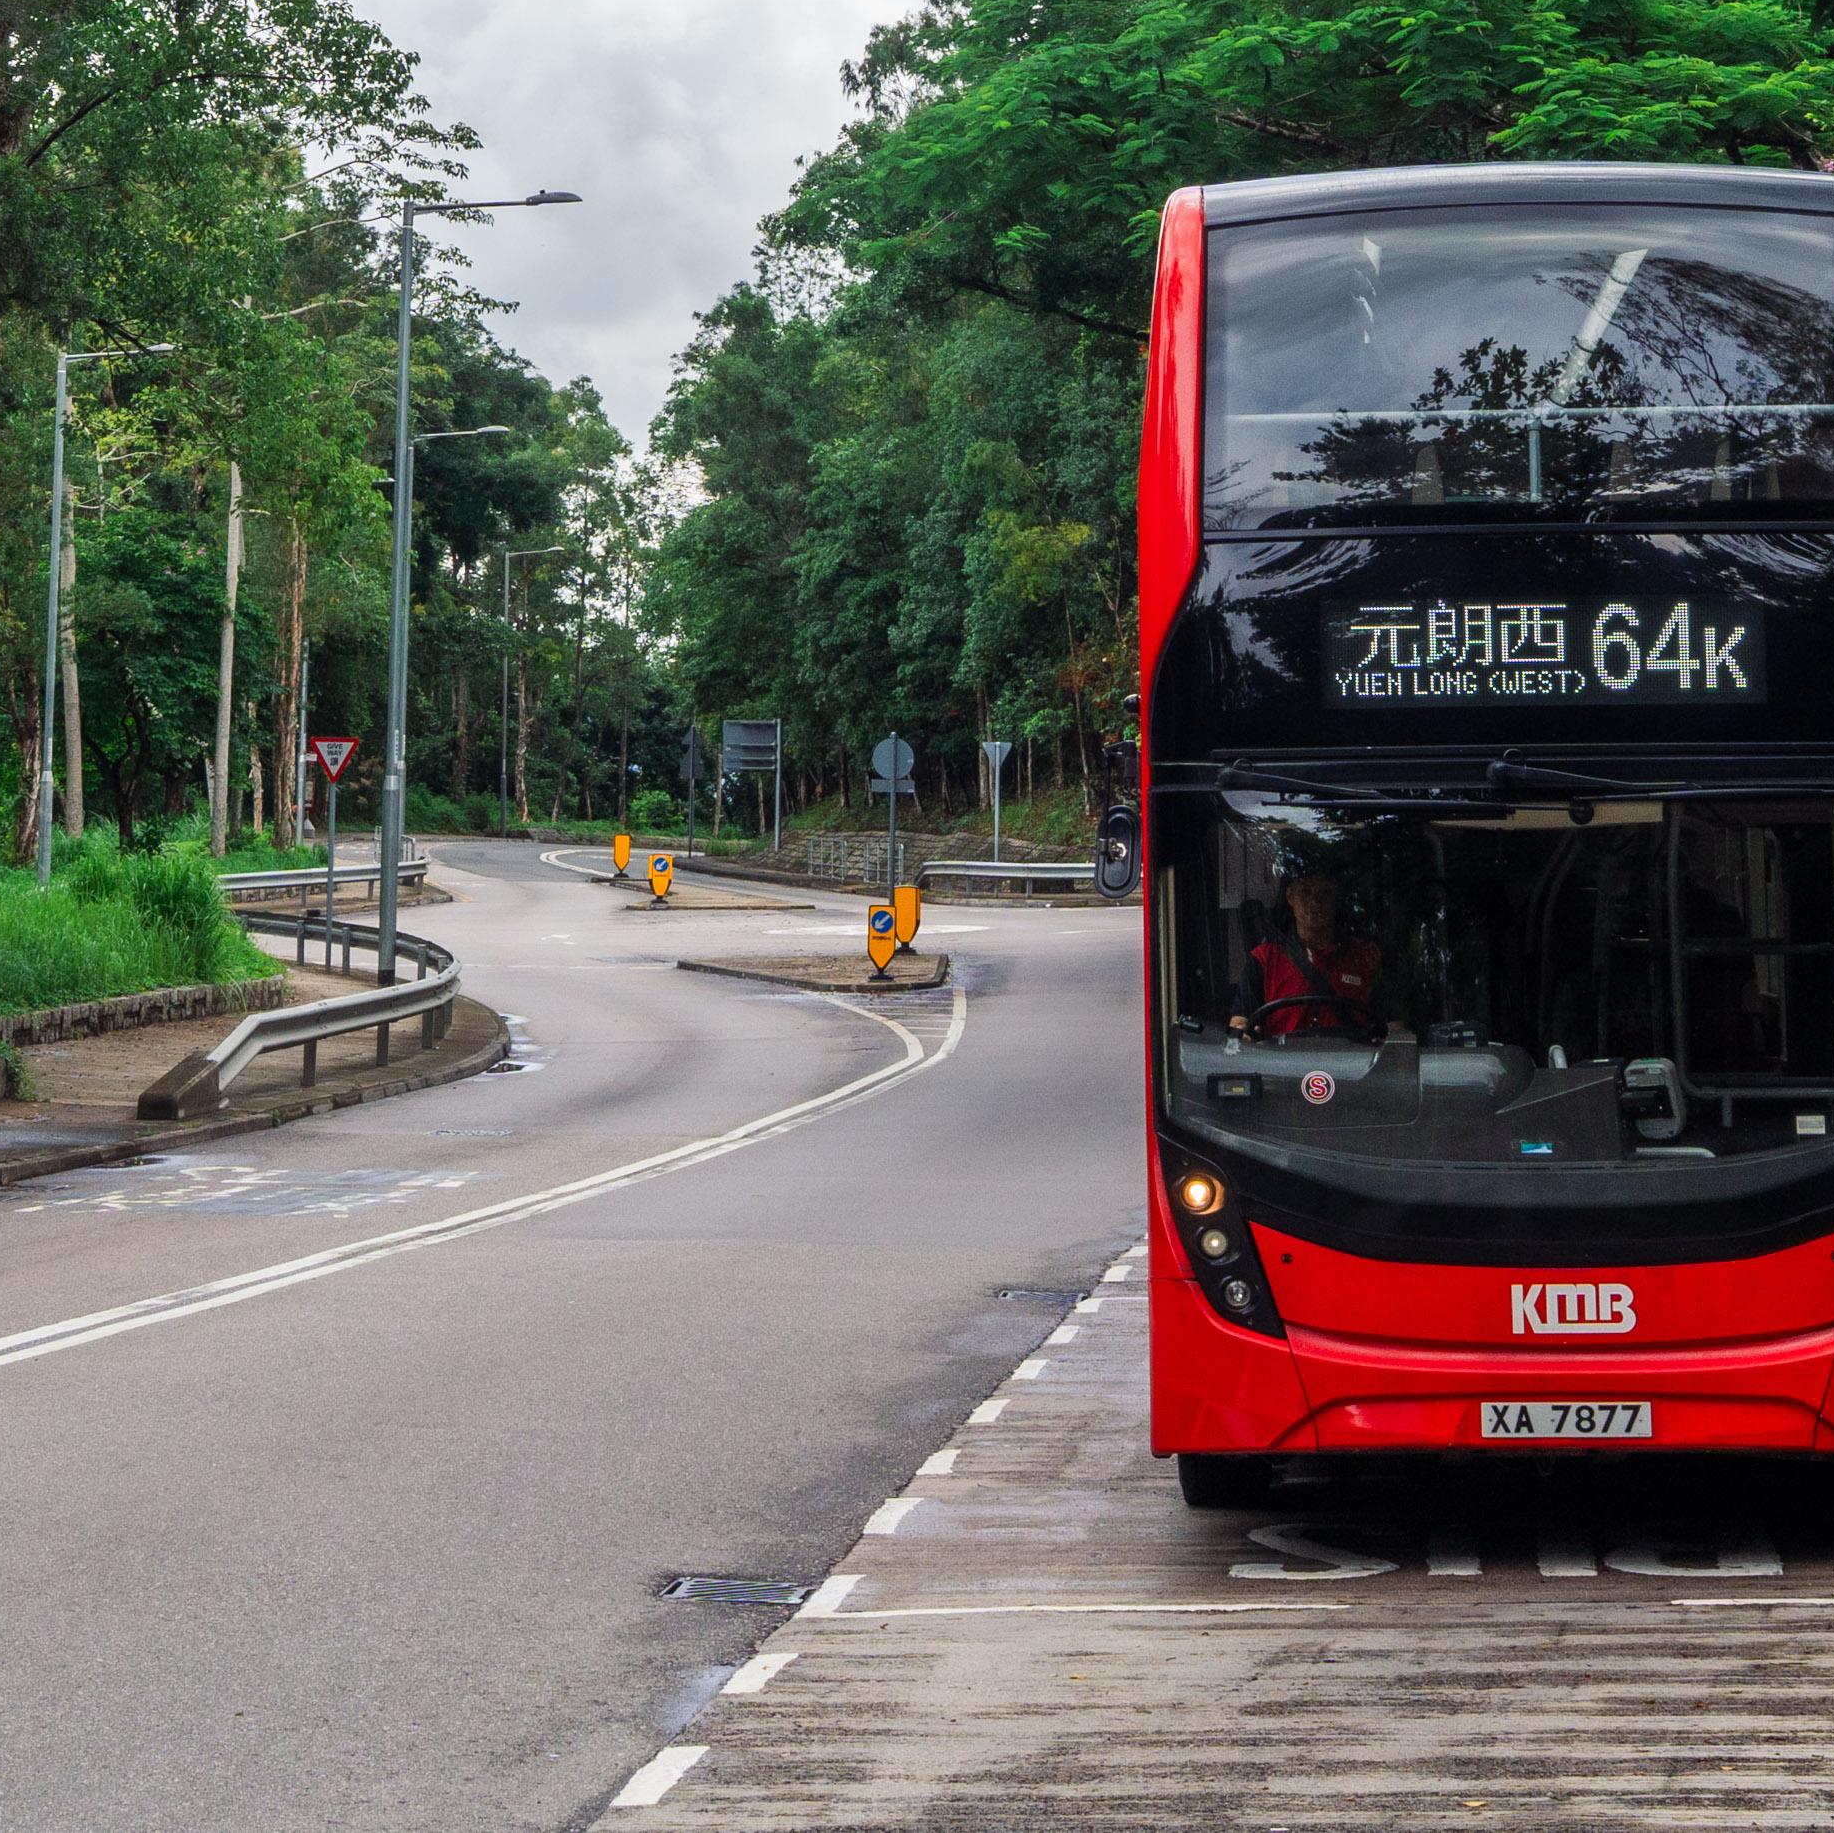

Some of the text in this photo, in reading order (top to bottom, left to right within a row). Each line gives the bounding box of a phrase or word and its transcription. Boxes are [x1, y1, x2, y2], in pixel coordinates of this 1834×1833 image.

[1350, 599, 1567, 668] 元朗西
[1592, 602, 1747, 689] 64K
[1335, 670, 1586, 696] YUEN LONG (WEST)
[1309, 1077, 1327, 1097] S
[1510, 1283, 1637, 1335] KMB
[1491, 1404, 1642, 1434] XA 7877
